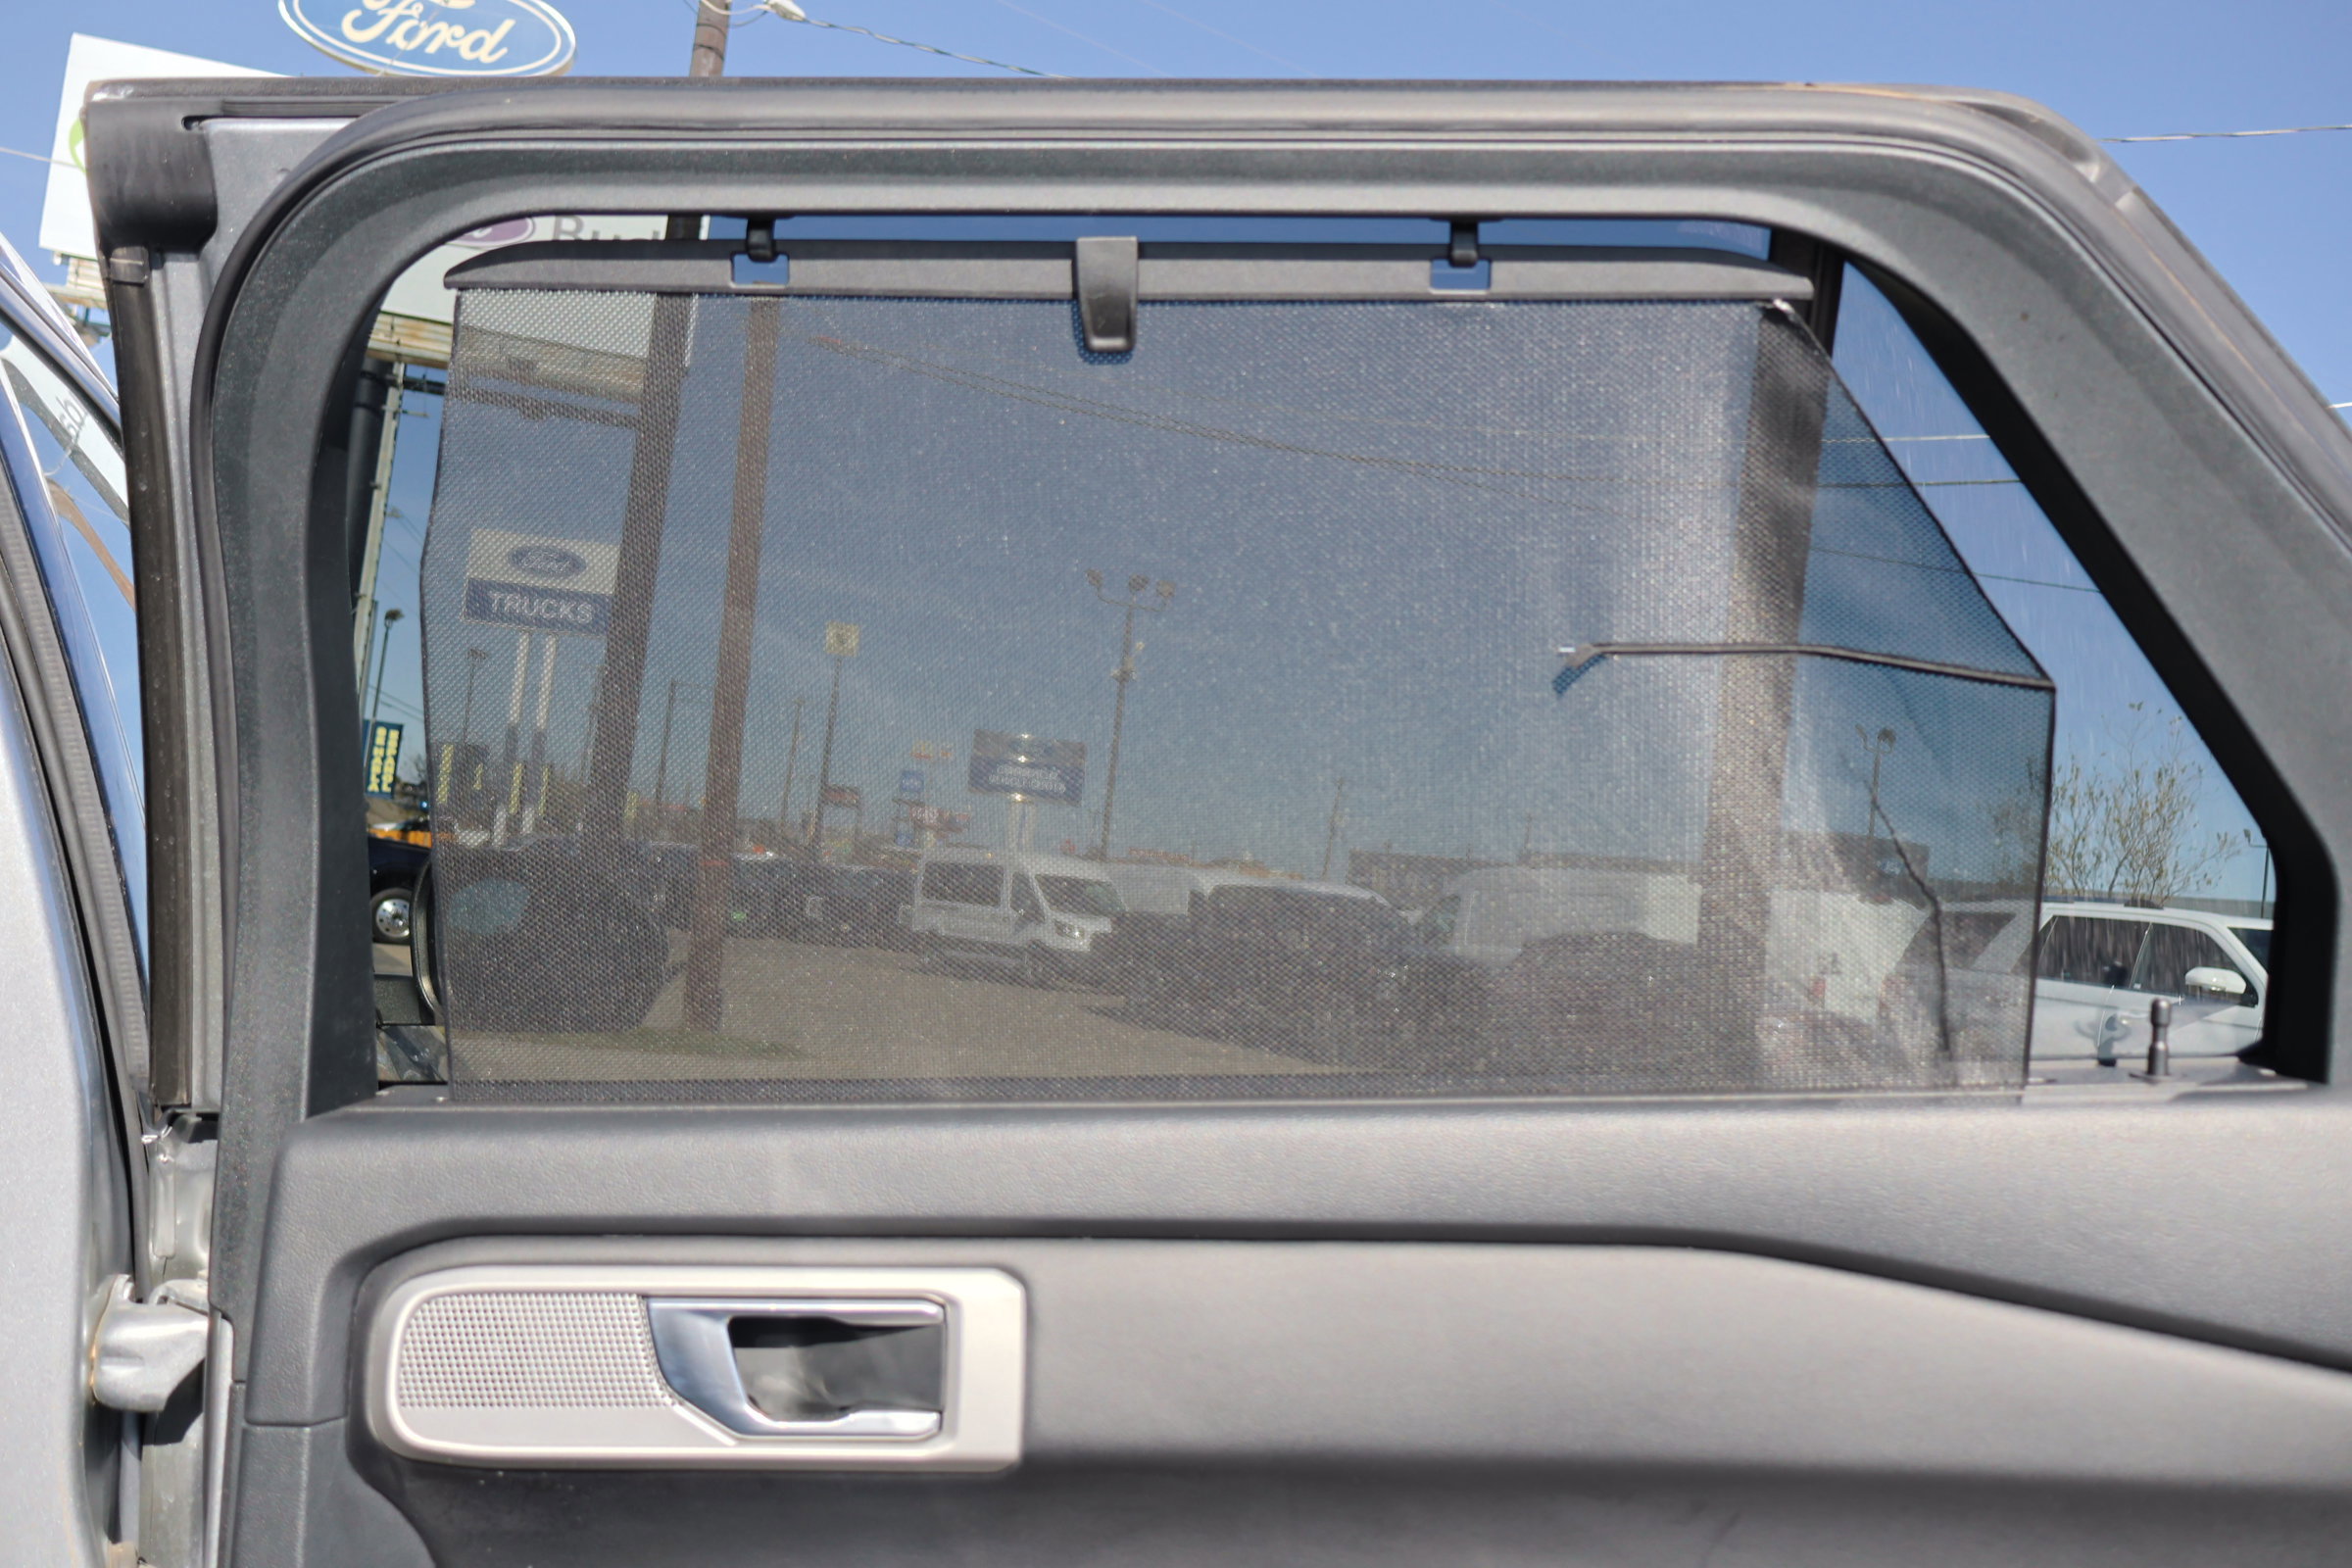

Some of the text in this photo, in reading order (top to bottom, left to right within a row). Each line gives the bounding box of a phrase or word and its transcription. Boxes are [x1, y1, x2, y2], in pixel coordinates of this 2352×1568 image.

[340, 0, 516, 63] Ford
[518, 550, 570, 574] Ford
[488, 590, 594, 624] TRUCKS
